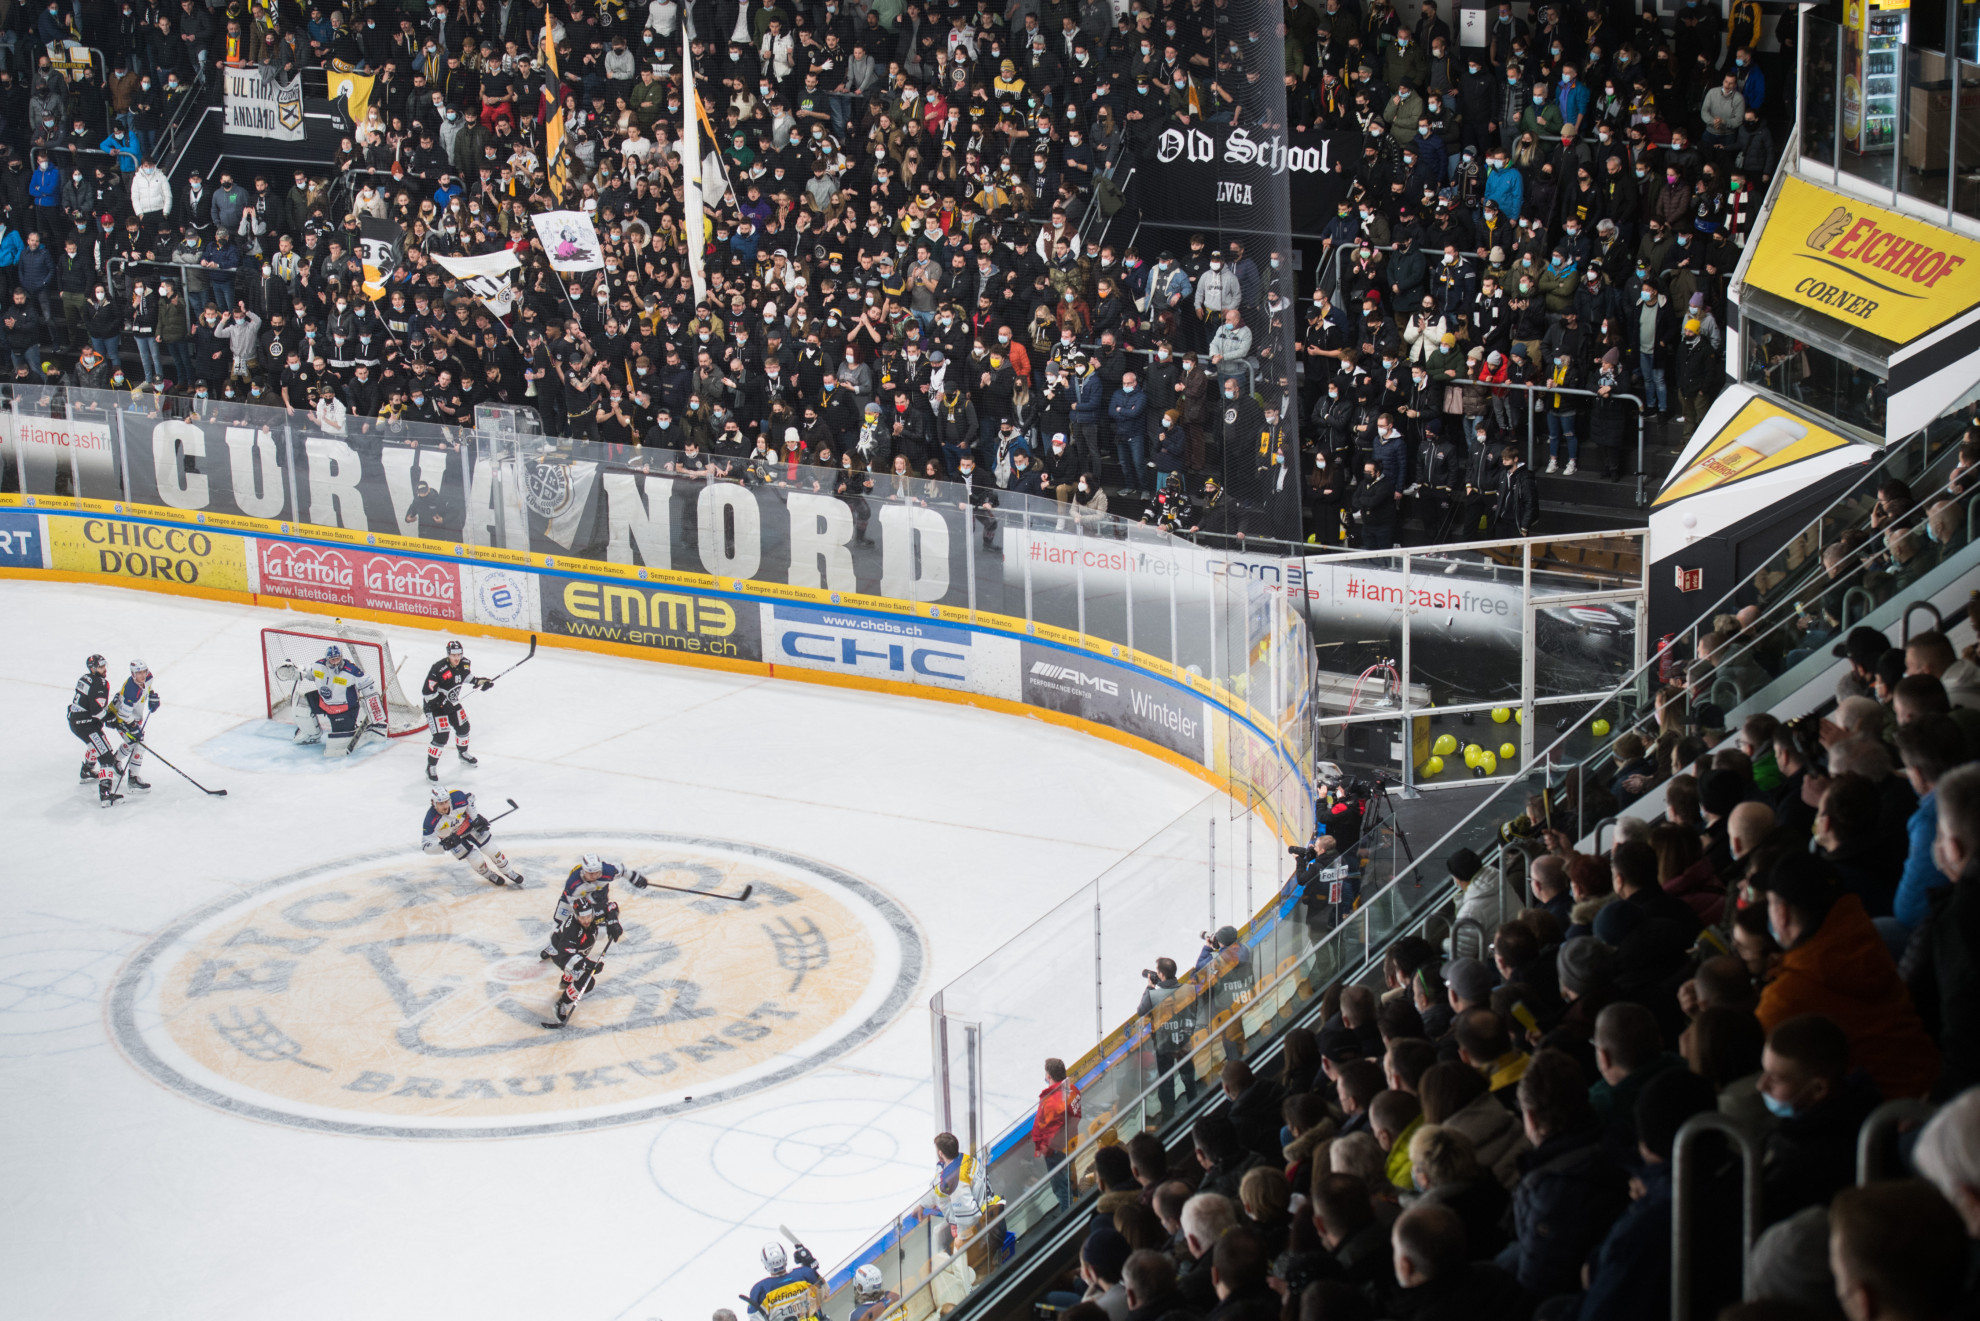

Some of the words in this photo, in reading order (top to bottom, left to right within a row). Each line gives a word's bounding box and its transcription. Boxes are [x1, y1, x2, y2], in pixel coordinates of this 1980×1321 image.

[1156, 128, 1214, 163] Old
[1224, 128, 1330, 176] School
[1828, 217, 1966, 288] EICHHOF
[1794, 277, 1880, 320] CORNER
[152, 419, 532, 551] CURVA
[603, 473, 950, 602] NORD
[84, 520, 212, 557] CHICCO
[99, 550, 199, 584] D'ORO
[262, 550, 282, 576] la
[286, 557, 353, 586] tettoia
[363, 564, 382, 590] la
[386, 569, 454, 599] tettoia
[266, 584, 354, 605] www.latettoia.ch
[366, 597, 455, 618] www.latettoia.ch
[1347, 578, 1508, 616] #iamcashfree
[567, 622, 737, 656] www.emme.ch
[823, 614, 922, 636] www.chcbs.ch
[782, 631, 966, 681] CHC
[1030, 678, 1070, 694] PERFORMANCE
[1071, 688, 1092, 700] CENTER
[1058, 667, 1118, 696] AMG
[1131, 688, 1198, 739] Winteler
[341, 1002, 800, 1099] BRAUKUNST
